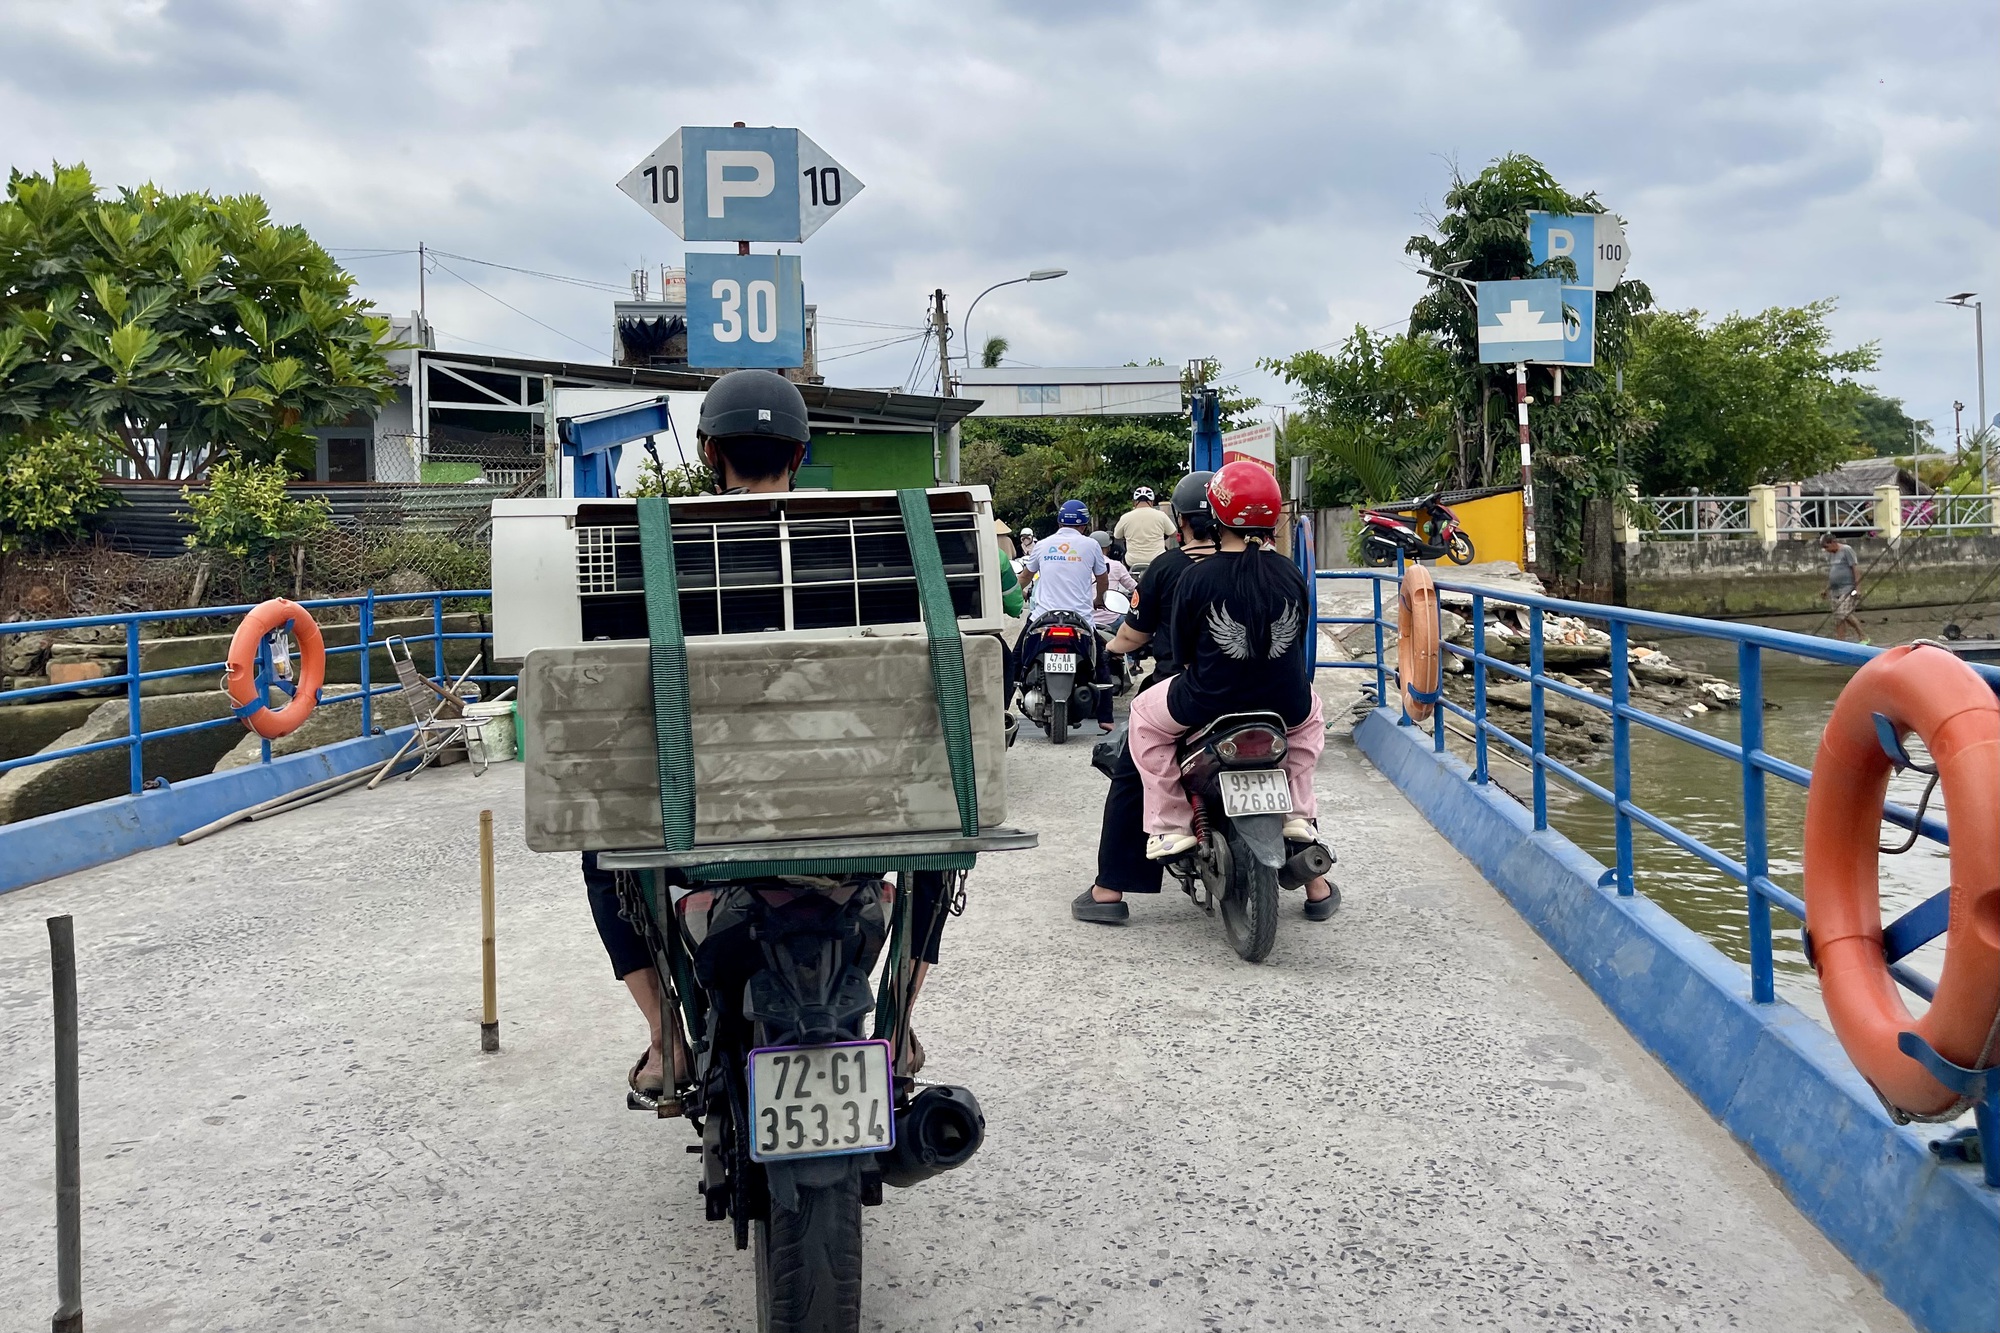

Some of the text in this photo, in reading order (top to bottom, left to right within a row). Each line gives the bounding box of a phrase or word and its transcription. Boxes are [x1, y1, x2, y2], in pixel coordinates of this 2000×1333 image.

[643, 165, 679, 204] 10
[706, 150, 776, 218] P
[803, 166, 841, 206] 10
[1597, 243, 1622, 261] 100
[711, 279, 777, 343] 30
[1046, 662, 1075, 672] 859.05
[1050, 654, 1071, 663] 47-AA
[1230, 773, 1277, 792] 93-P1
[1229, 792, 1288, 813] 426.88
[761, 1099, 885, 1151] 353.34
